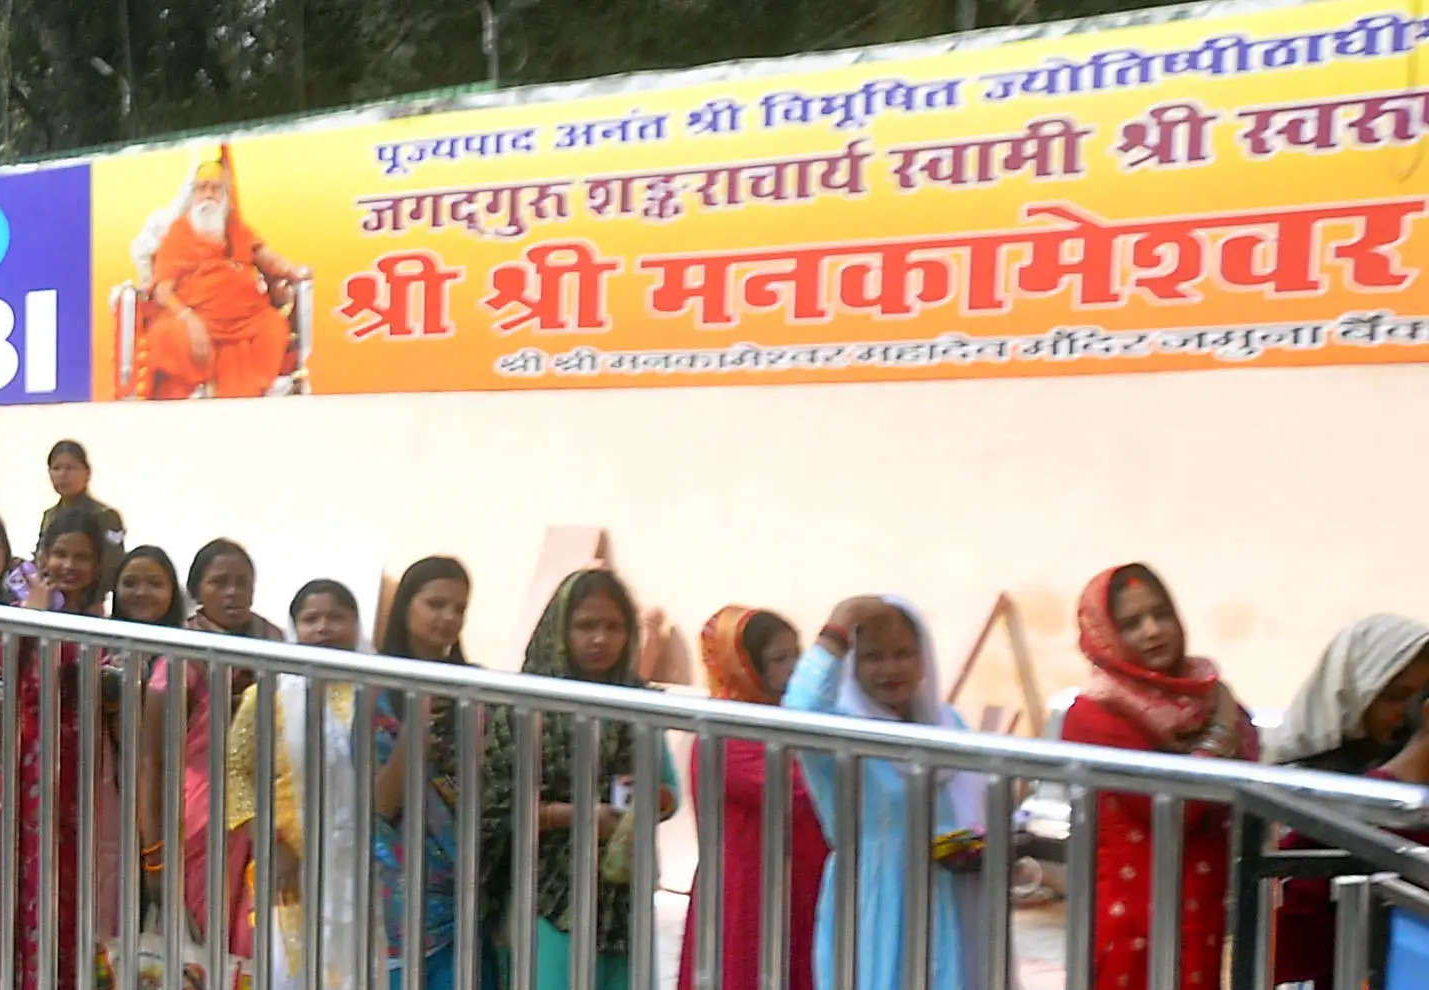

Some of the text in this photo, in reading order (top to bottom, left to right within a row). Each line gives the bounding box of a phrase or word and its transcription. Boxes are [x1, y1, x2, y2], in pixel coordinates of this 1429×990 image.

[357, 181, 573, 236] जगद्गुरु
[888, 119, 1091, 188] स्वामी
[1116, 104, 1217, 167] श्री
[1238, 92, 1429, 154] स्वरू
[376, 127, 537, 174] पूज्यपाद
[555, 109, 668, 149] अनंत
[685, 101, 742, 133] श्री
[760, 80, 965, 129] विभूषित
[341, 200, 1425, 337] श्री श्री मनकामेश्वर
[500, 351, 541, 372] श्री
[554, 350, 597, 372] श्री
[856, 338, 1007, 363] महादेव
